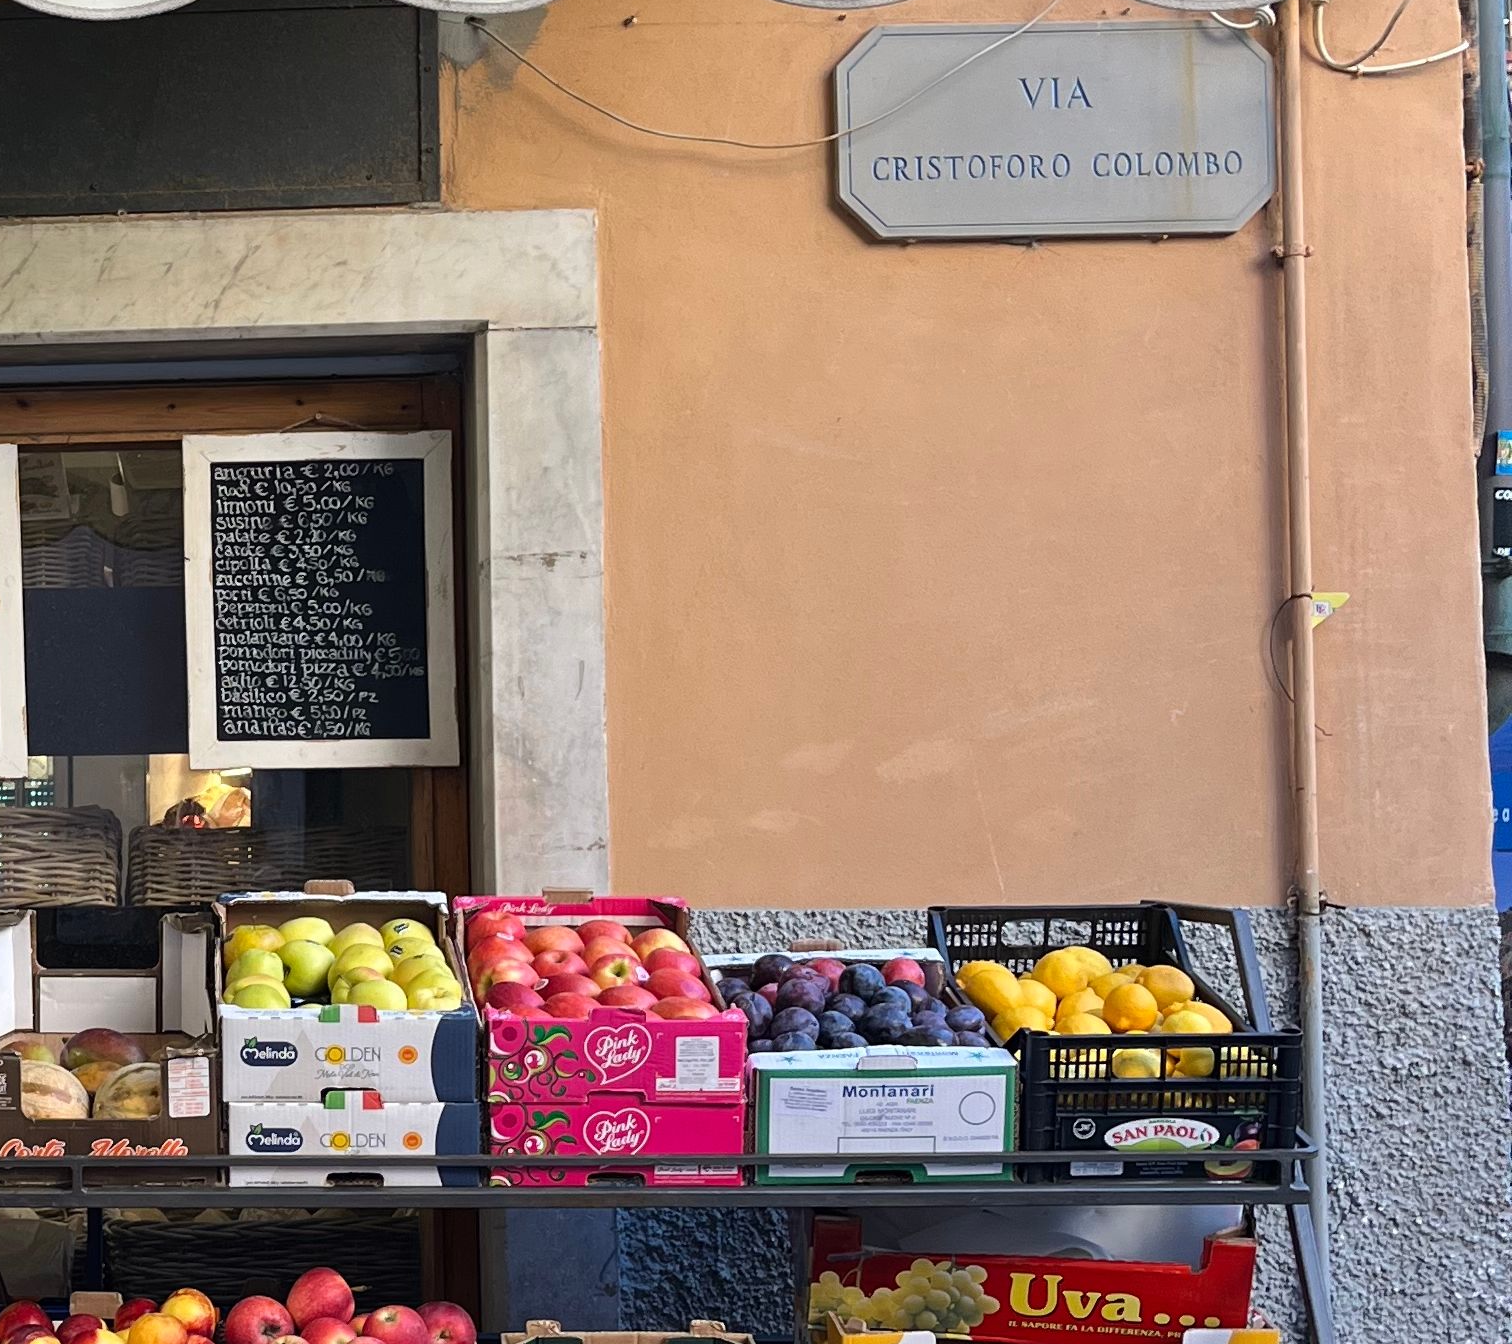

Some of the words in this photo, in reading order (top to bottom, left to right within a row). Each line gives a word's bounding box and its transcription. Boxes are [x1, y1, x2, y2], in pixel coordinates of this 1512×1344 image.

[1019, 77, 1093, 110] VIA
[872, 154, 1071, 182] CRISTOFORO
[1092, 150, 1243, 178] COLOMBO
[214, 464, 296, 484] anguria
[216, 496, 276, 515] limoni
[216, 515, 273, 530] susine
[214, 529, 271, 545] patate
[215, 556, 272, 574] cipolla
[215, 570, 292, 587] zucchine
[215, 587, 253, 602] porri
[215, 614, 277, 631] cetrioli
[219, 630, 312, 646] melanzane
[217, 644, 295, 660] pomodori
[299, 645, 372, 664] piccadilly
[217, 659, 297, 674] pomodori
[300, 661, 350, 678] pizza
[220, 674, 262, 691] aglio
[220, 688, 287, 703] basilico
[220, 705, 288, 720] mango
[222, 718, 298, 737] ananas
[596, 1030, 640, 1058] Pink
[241, 1045, 296, 1061] Melinda
[314, 1046, 382, 1063] GOLDEN
[602, 1047, 643, 1069] Lady
[841, 1084, 935, 1099] Montanari
[594, 1114, 638, 1142] Pink
[1112, 1125, 1148, 1144] SAN
[1154, 1124, 1213, 1144] PAOLO
[247, 1131, 302, 1147] Melinda
[319, 1132, 386, 1149] GOLDEN
[600, 1131, 642, 1153] Lady
[1021, 1321, 1063, 1331] SAPORE
[1065, 1324, 1079, 1332] FA
[1081, 1324, 1095, 1333] LA
